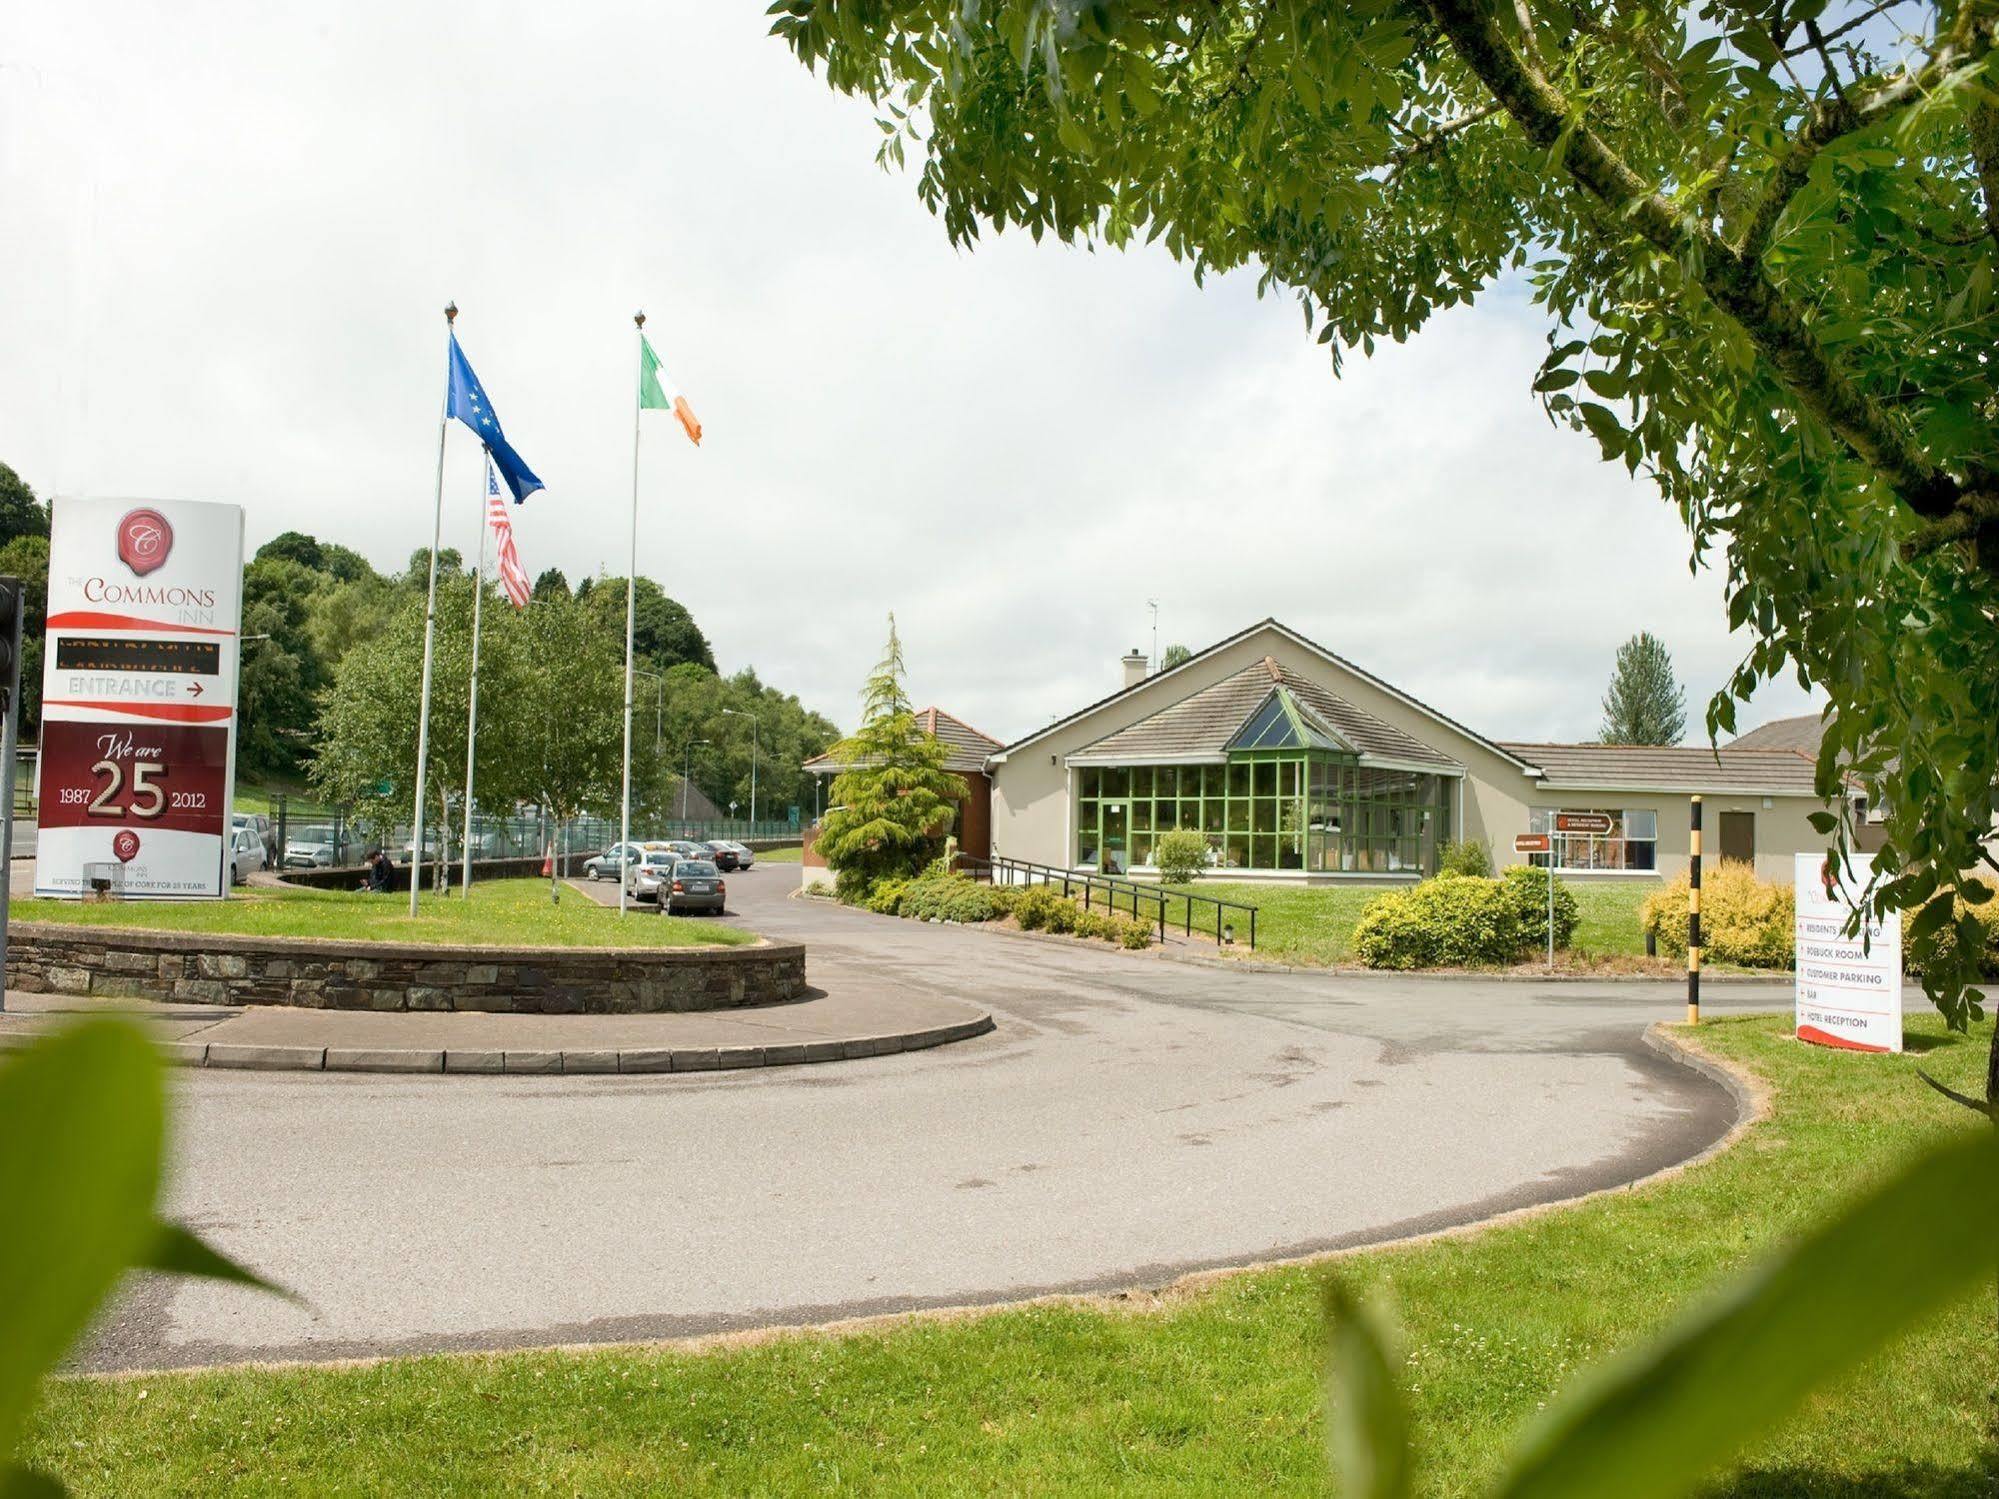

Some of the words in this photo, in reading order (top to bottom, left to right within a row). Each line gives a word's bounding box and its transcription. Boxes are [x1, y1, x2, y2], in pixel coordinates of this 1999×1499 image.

[68, 577, 82, 587] THE
[84, 577, 215, 608] COMMONS
[178, 608, 214, 624] INN
[69, 677, 176, 697] ENTRANCE
[97, 730, 133, 759] We
[135, 746, 162, 758] are
[59, 788, 92, 804] 1987
[87, 760, 169, 819] 25
[172, 792, 206, 809] 2012
[1806, 924, 1837, 935] RESIDENTS
[1835, 950, 1863, 959] ROOM
[1806, 967, 1838, 980] CUSTOMER
[1840, 972, 1882, 984] PARKING
[1807, 1012, 1824, 1023] HOTEL
[1824, 1013, 1868, 1028] RECEPTION
